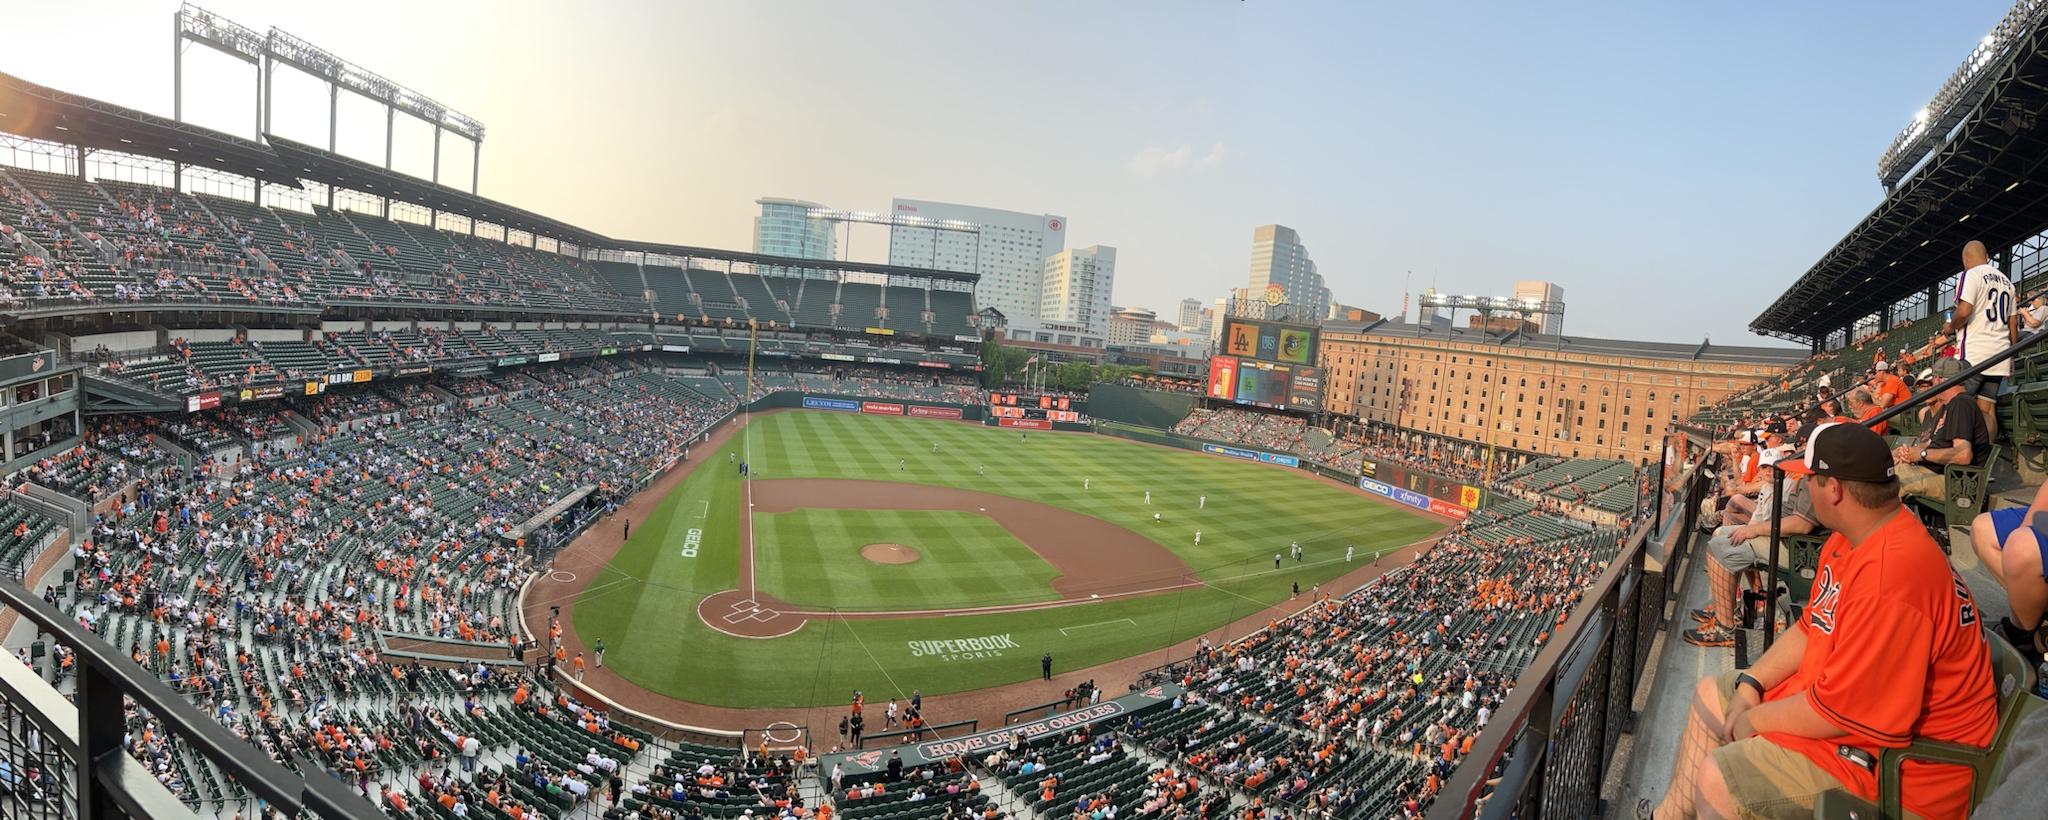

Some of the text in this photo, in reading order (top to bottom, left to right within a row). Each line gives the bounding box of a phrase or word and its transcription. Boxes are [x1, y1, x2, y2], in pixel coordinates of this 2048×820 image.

[1985, 287, 2010, 325] 30
[1234, 328, 1249, 352] LA
[330, 373, 341, 384] OLD
[1300, 397, 1316, 406] PNC
[1363, 480, 1389, 494] GEICO
[1400, 491, 1422, 506] xfinity
[681, 528, 703, 558] GEICO
[908, 633, 1020, 657] SUPERBOOK
[942, 650, 1003, 661] SPORTS
[929, 735, 987, 757] HOME
[987, 731, 1010, 745] OF
[1050, 704, 1116, 729] ORIOLES
